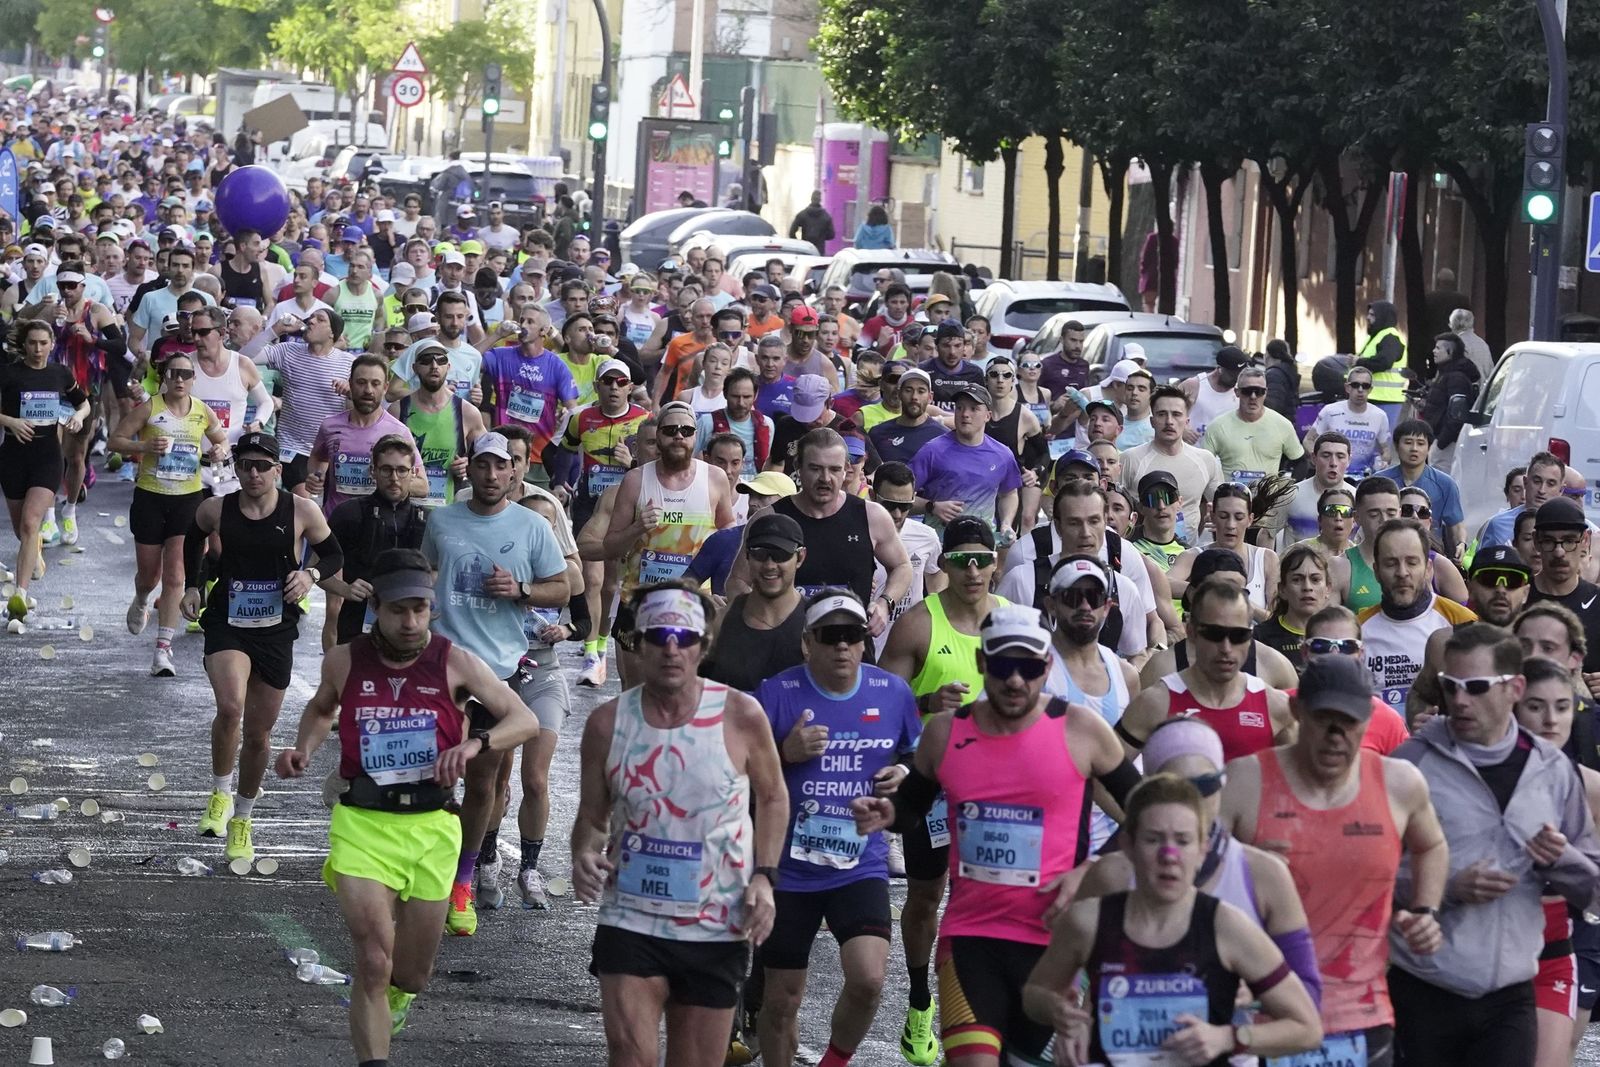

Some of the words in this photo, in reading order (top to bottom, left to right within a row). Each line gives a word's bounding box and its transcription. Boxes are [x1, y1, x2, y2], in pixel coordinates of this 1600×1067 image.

[399, 84, 419, 97] 30
[25, 410, 54, 418] MARRIS
[509, 401, 530, 413] PEDRO
[531, 408, 540, 417] PE
[335, 474, 376, 486] EDU/CARO
[663, 511, 683, 523] MSR
[659, 554, 687, 564] ZURICH
[246, 583, 277, 591] ZURICH
[236, 604, 275, 617] ÁLVARO
[1368, 656, 1383, 673] 48
[1384, 655, 1411, 665] MEDIA
[782, 680, 800, 689] RUN
[868, 678, 889, 688] RUN
[385, 718, 427, 731] ZURICH
[386, 740, 409, 750] 6717
[365, 753, 396, 770] LUIS
[399, 747, 435, 767] JOSÉ
[821, 755, 863, 772] CHILE
[802, 780, 874, 796] GERMAN
[824, 804, 856, 818] ZURIC
[984, 806, 1033, 821] ZURICH
[821, 825, 842, 835] 9181
[645, 842, 693, 857] ZURICH
[800, 833, 861, 855] GERMAIN
[976, 846, 1016, 865] PAPO
[646, 864, 670, 877] 5483
[641, 878, 673, 897] MEL
[1134, 978, 1195, 994] ZURICH
